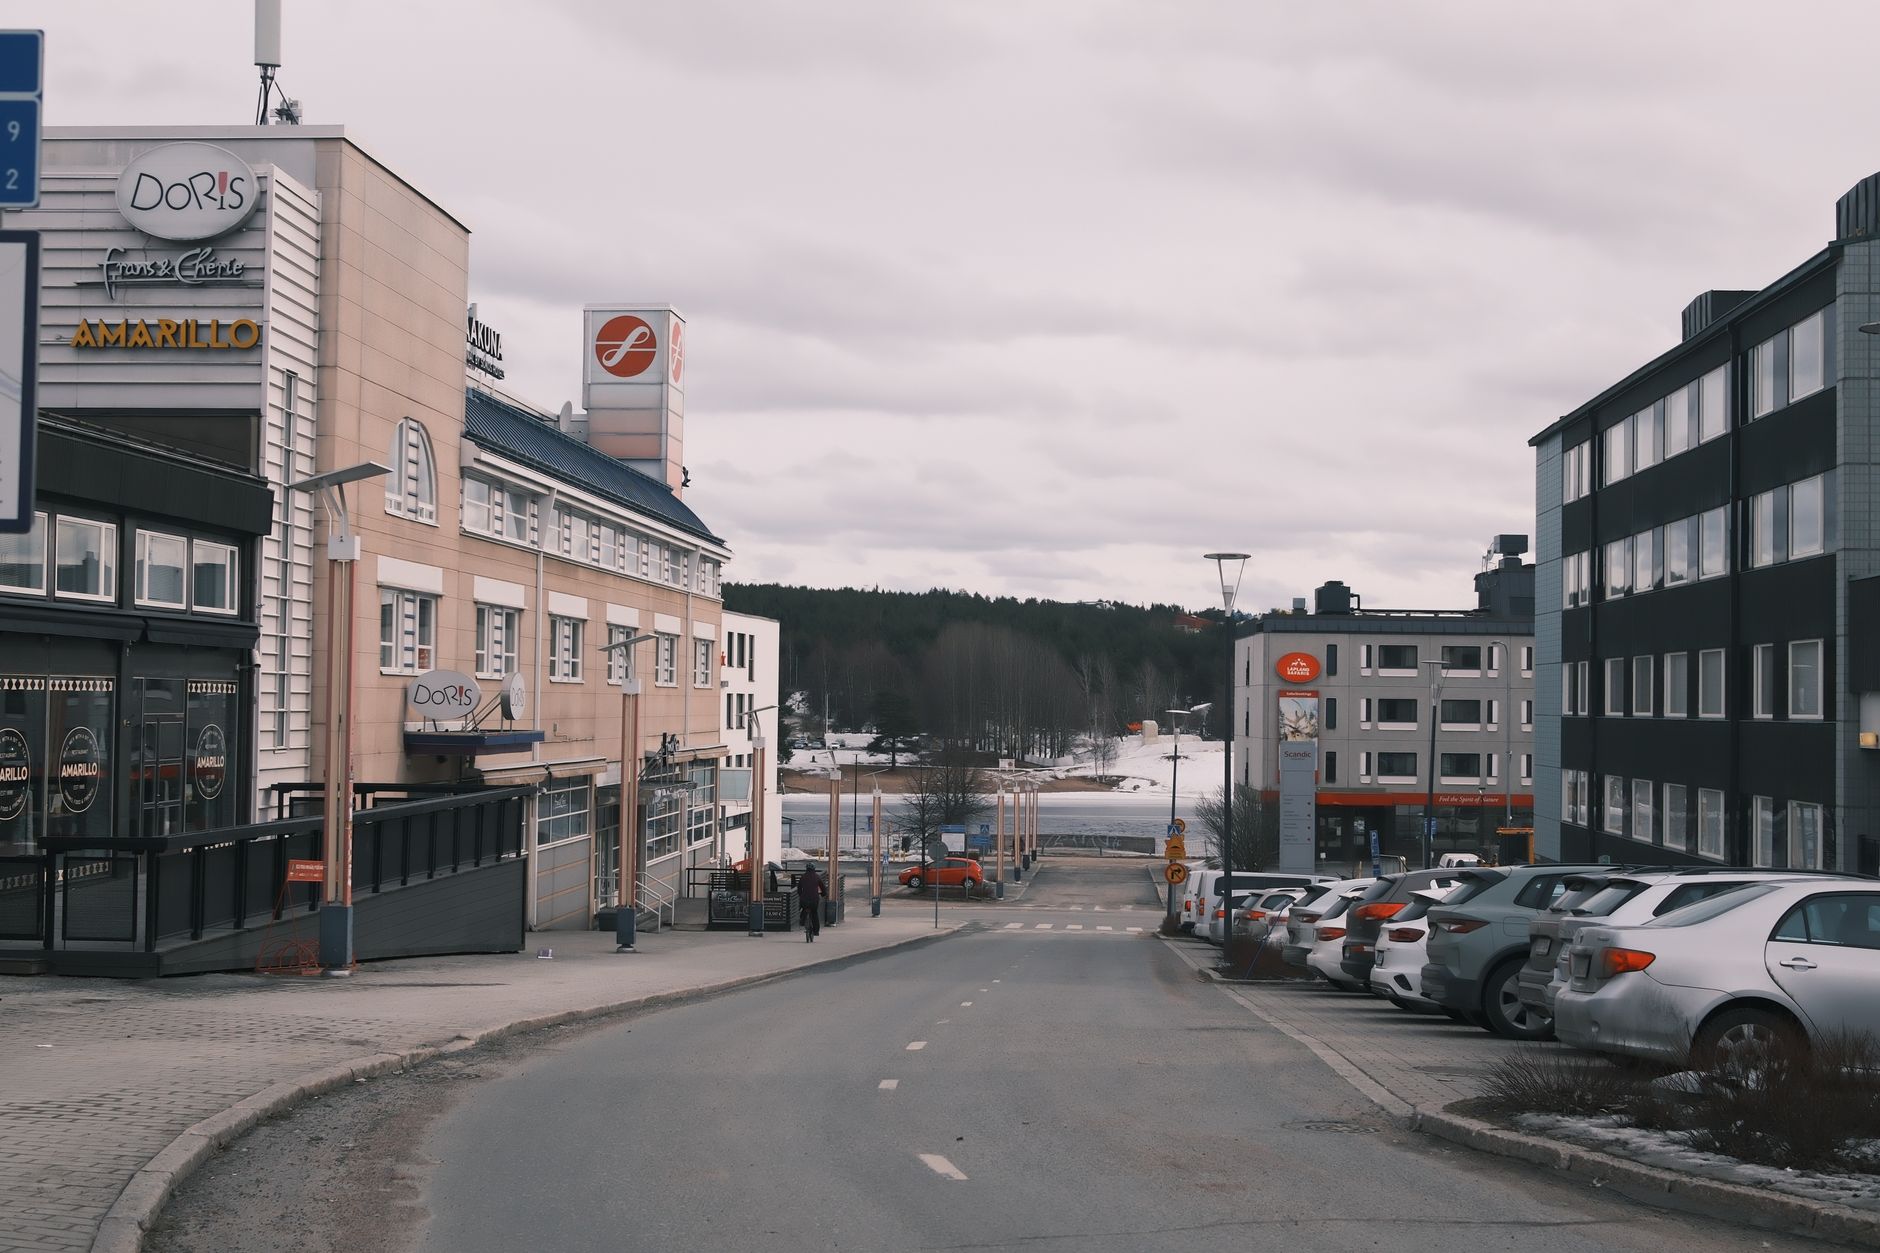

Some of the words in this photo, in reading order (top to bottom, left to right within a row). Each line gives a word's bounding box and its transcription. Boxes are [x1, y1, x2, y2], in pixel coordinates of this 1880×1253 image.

[6, 168, 19, 190] 2
[69, 317, 262, 349] AMARILLO
[196, 755, 225, 769] AMARILLO
[1284, 750, 1312, 758] Scandic
[60, 762, 98, 778] AMARILLO
